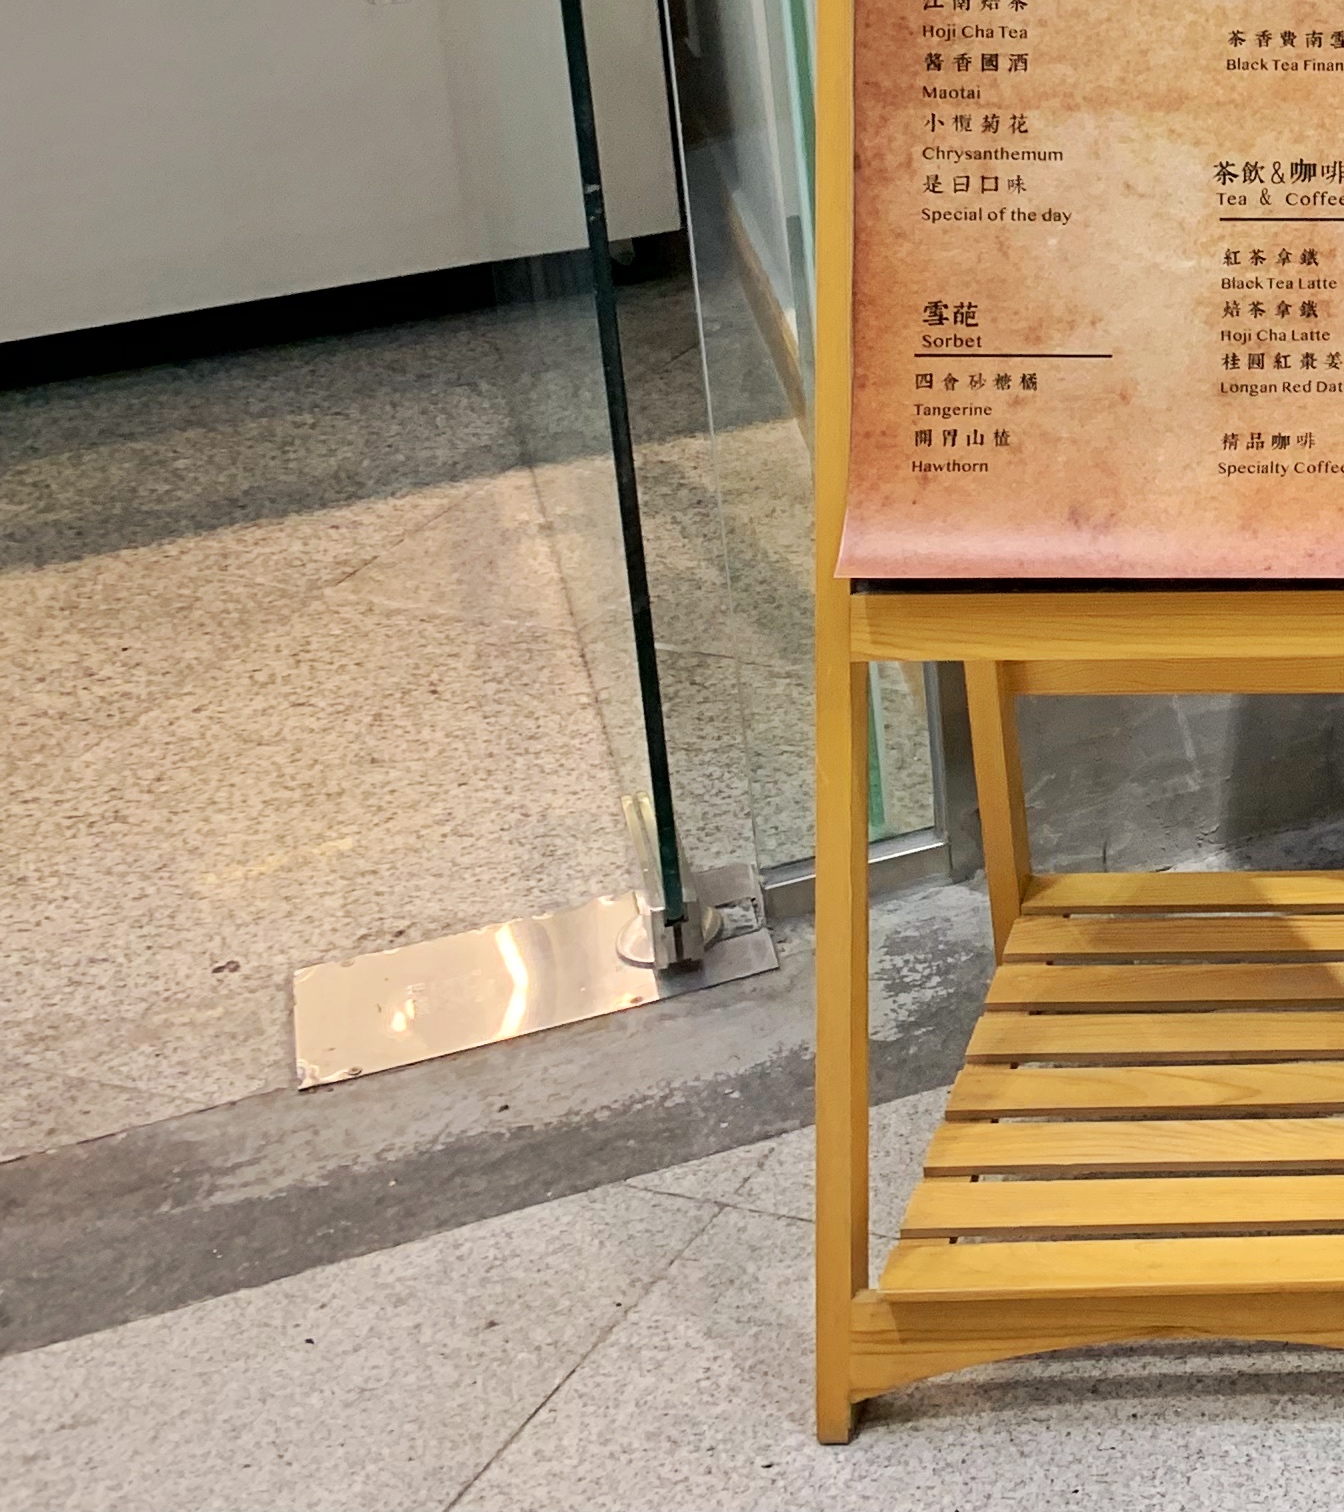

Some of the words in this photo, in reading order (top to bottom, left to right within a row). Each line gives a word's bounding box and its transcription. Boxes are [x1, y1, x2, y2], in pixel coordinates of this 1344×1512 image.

[923, 24, 956, 41] Hoji
[962, 25, 994, 39] Cha
[999, 26, 1028, 39] Tea
[1226, 58, 1268, 71] Black
[1272, 59, 1298, 71] Tea
[921, 85, 981, 100] Maotai
[922, 146, 1063, 163] Chrysanthemum
[1216, 192, 1247, 205] Tea
[1259, 188, 1272, 206] &
[922, 207, 982, 223] Special
[988, 208, 1007, 221] of
[1011, 209, 1037, 222] the
[1041, 208, 1072, 225] day
[1221, 277, 1263, 289] Black
[1266, 278, 1293, 289] Tea
[1298, 278, 1338, 290] Latte
[923, 300, 979, 327] 雪葩
[922, 335, 982, 348] Sorbet
[1221, 329, 1252, 344] Hoji
[1257, 329, 1287, 342] Cha
[1291, 330, 1330, 342] Latte
[915, 372, 1038, 391] 四會砂糖橘
[1220, 381, 1277, 396] Longan
[1282, 380, 1312, 393] Red
[914, 403, 992, 419] Tangerine
[1221, 432, 1317, 451] 精品咖啡
[912, 460, 988, 472] Hawthorn
[1218, 461, 1289, 477] Specialty
